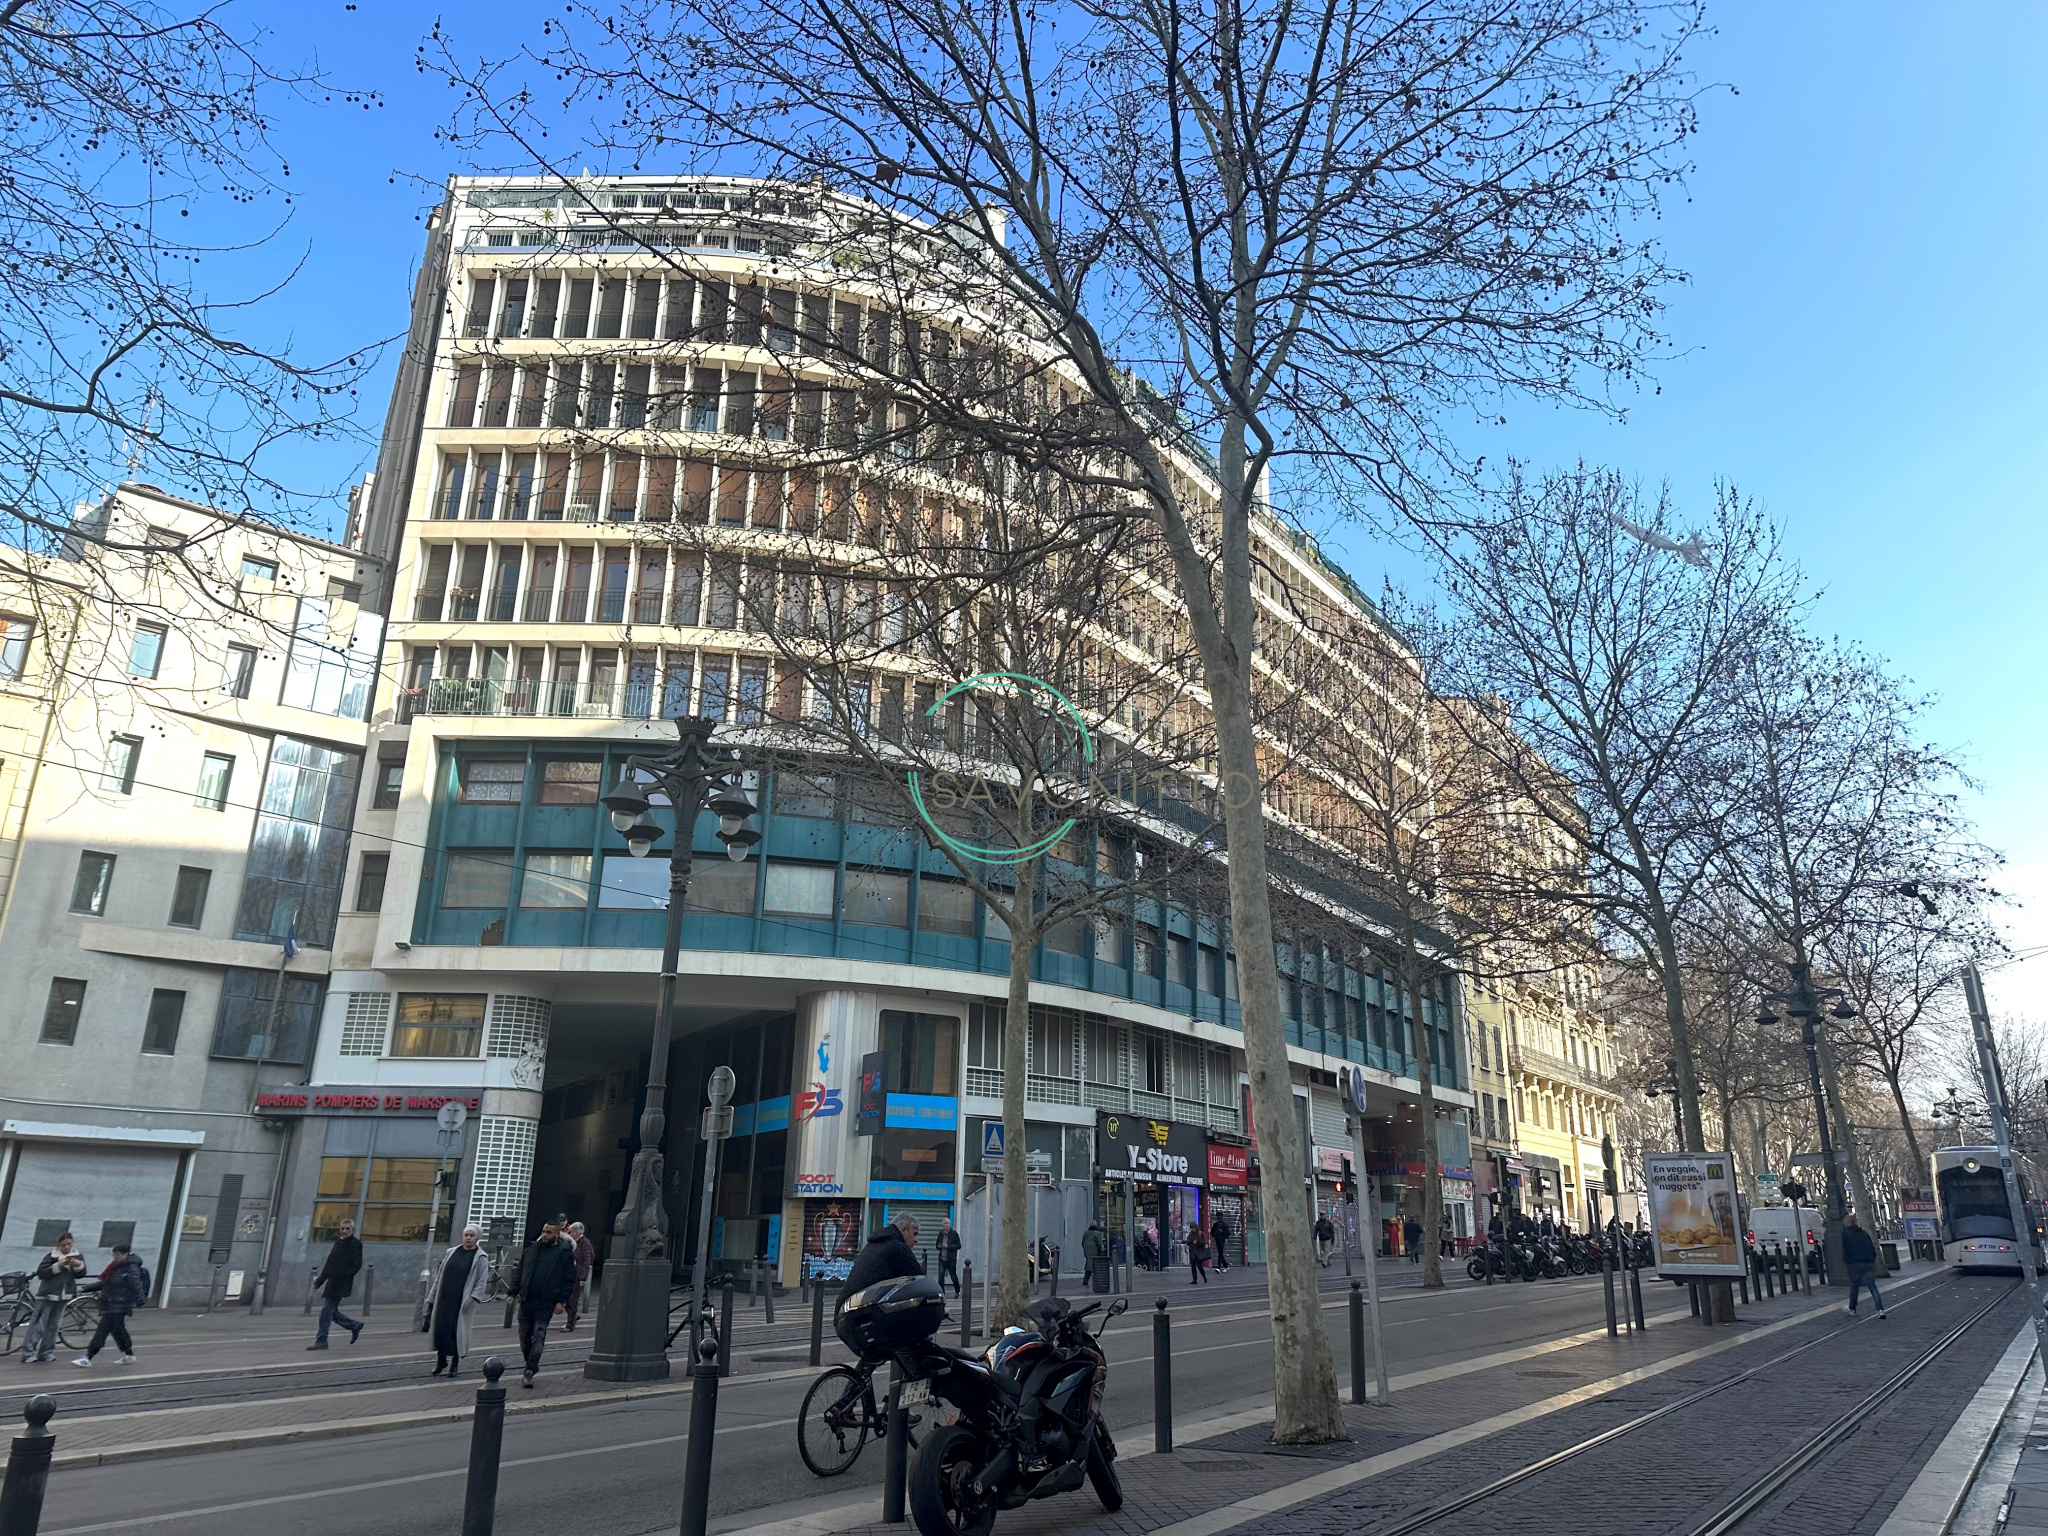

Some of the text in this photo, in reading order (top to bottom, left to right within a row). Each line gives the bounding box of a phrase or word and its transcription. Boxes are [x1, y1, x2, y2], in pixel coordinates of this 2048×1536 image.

[257, 1093, 479, 1110] MARINS POMPIERS DE MARSELE
[860, 1110, 881, 1119] STATION
[918, 1107, 955, 1120] CONTINUE
[1126, 1145, 1188, 1174] Y-Store
[1210, 1150, 1226, 1166] Time
[1666, 1165, 1699, 1174] veggie,
[798, 1174, 835, 1184] FOOT
[1104, 1168, 1127, 1179] ARTICLES
[1134, 1171, 1152, 1181] MAISON
[1156, 1173, 1183, 1184] ALIMENTAIRE
[1667, 1174, 1680, 1182] dit
[1682, 1173, 1706, 1181] aussi
[793, 1183, 843, 1194] STATION
[881, 1185, 905, 1195] JAMAIS
[907, 1186, 918, 1196] LES
